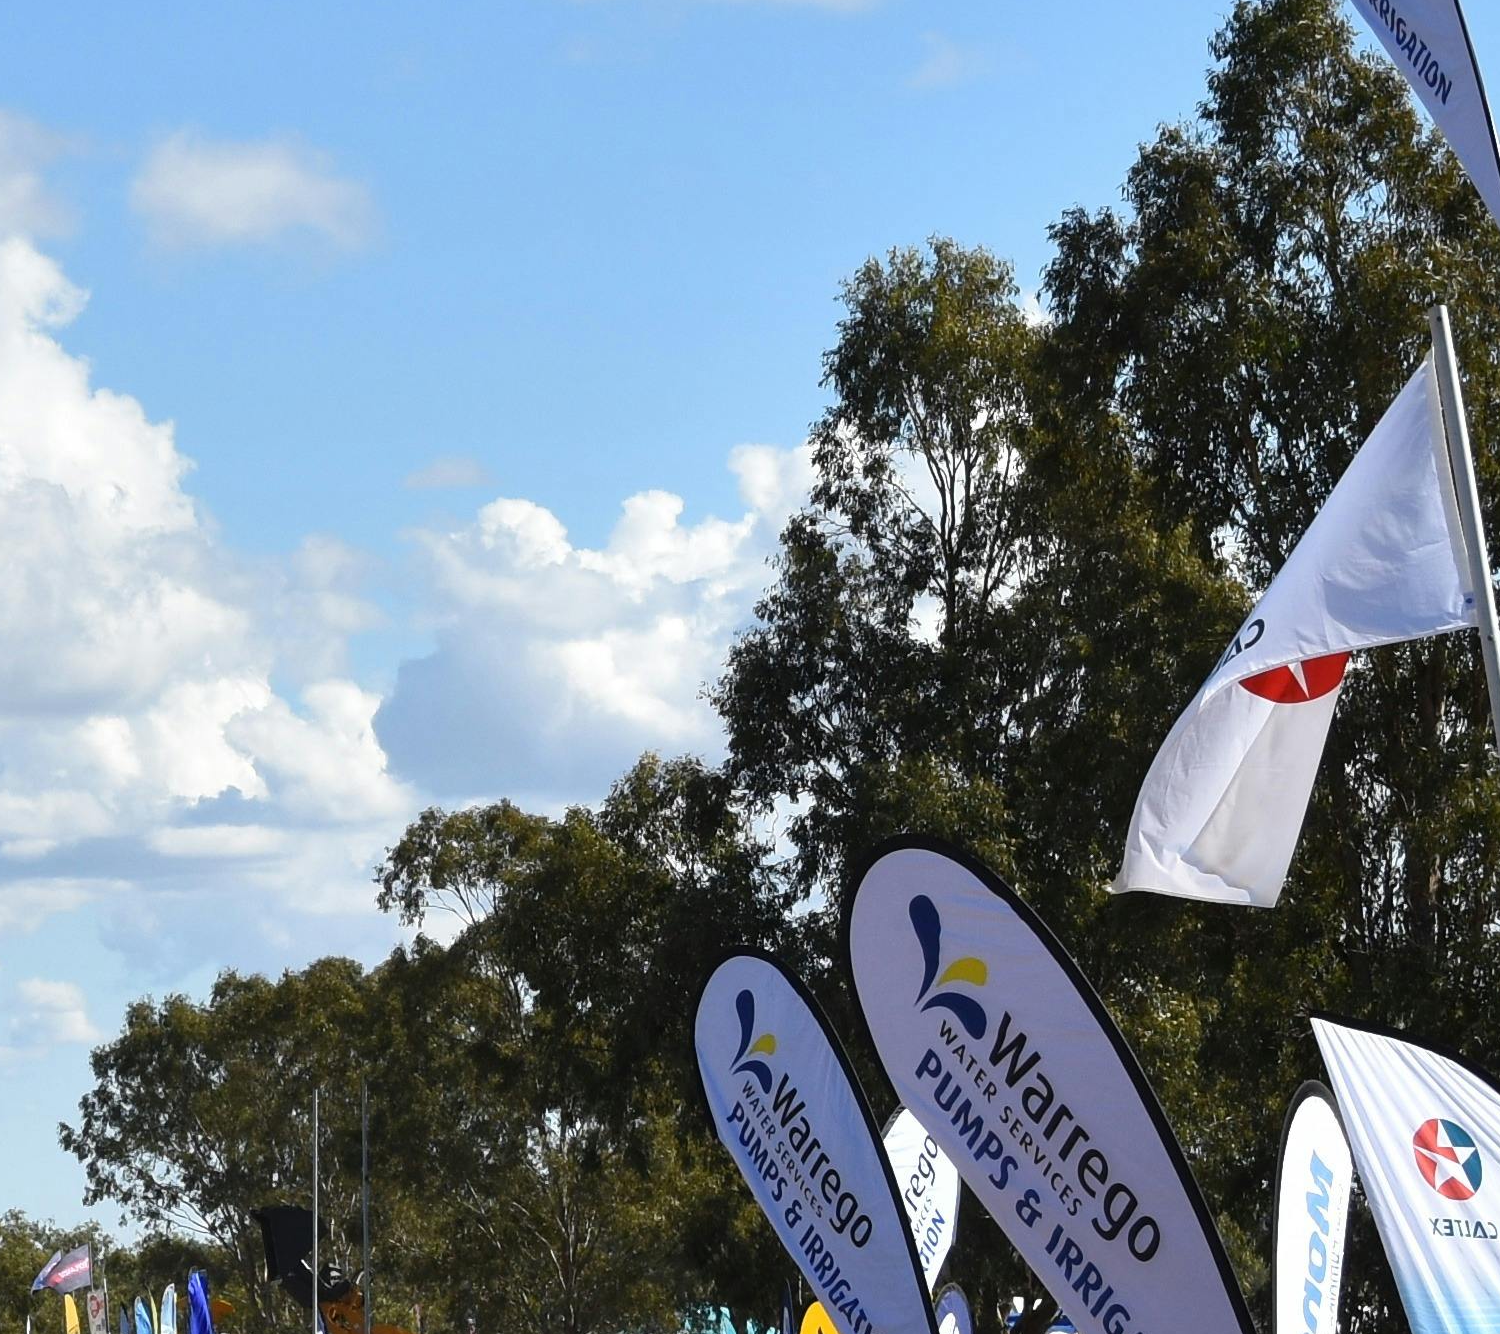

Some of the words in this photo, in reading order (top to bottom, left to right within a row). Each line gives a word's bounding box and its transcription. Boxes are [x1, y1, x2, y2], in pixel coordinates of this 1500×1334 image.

[725, 1101, 783, 1204] PUMPS
[781, 1196, 803, 1229] &
[740, 1080, 774, 1138] WATER
[772, 1136, 824, 1219] SERVICES
[771, 1071, 873, 1250] Warrego
[904, 1135, 938, 1211] rego
[914, 1048, 1019, 1191] PUMPS
[1015, 1187, 1042, 1221] &
[937, 1019, 996, 1098] WATER
[998, 1099, 1085, 1219] SERVICES
[987, 1009, 1163, 1264] Warrego
